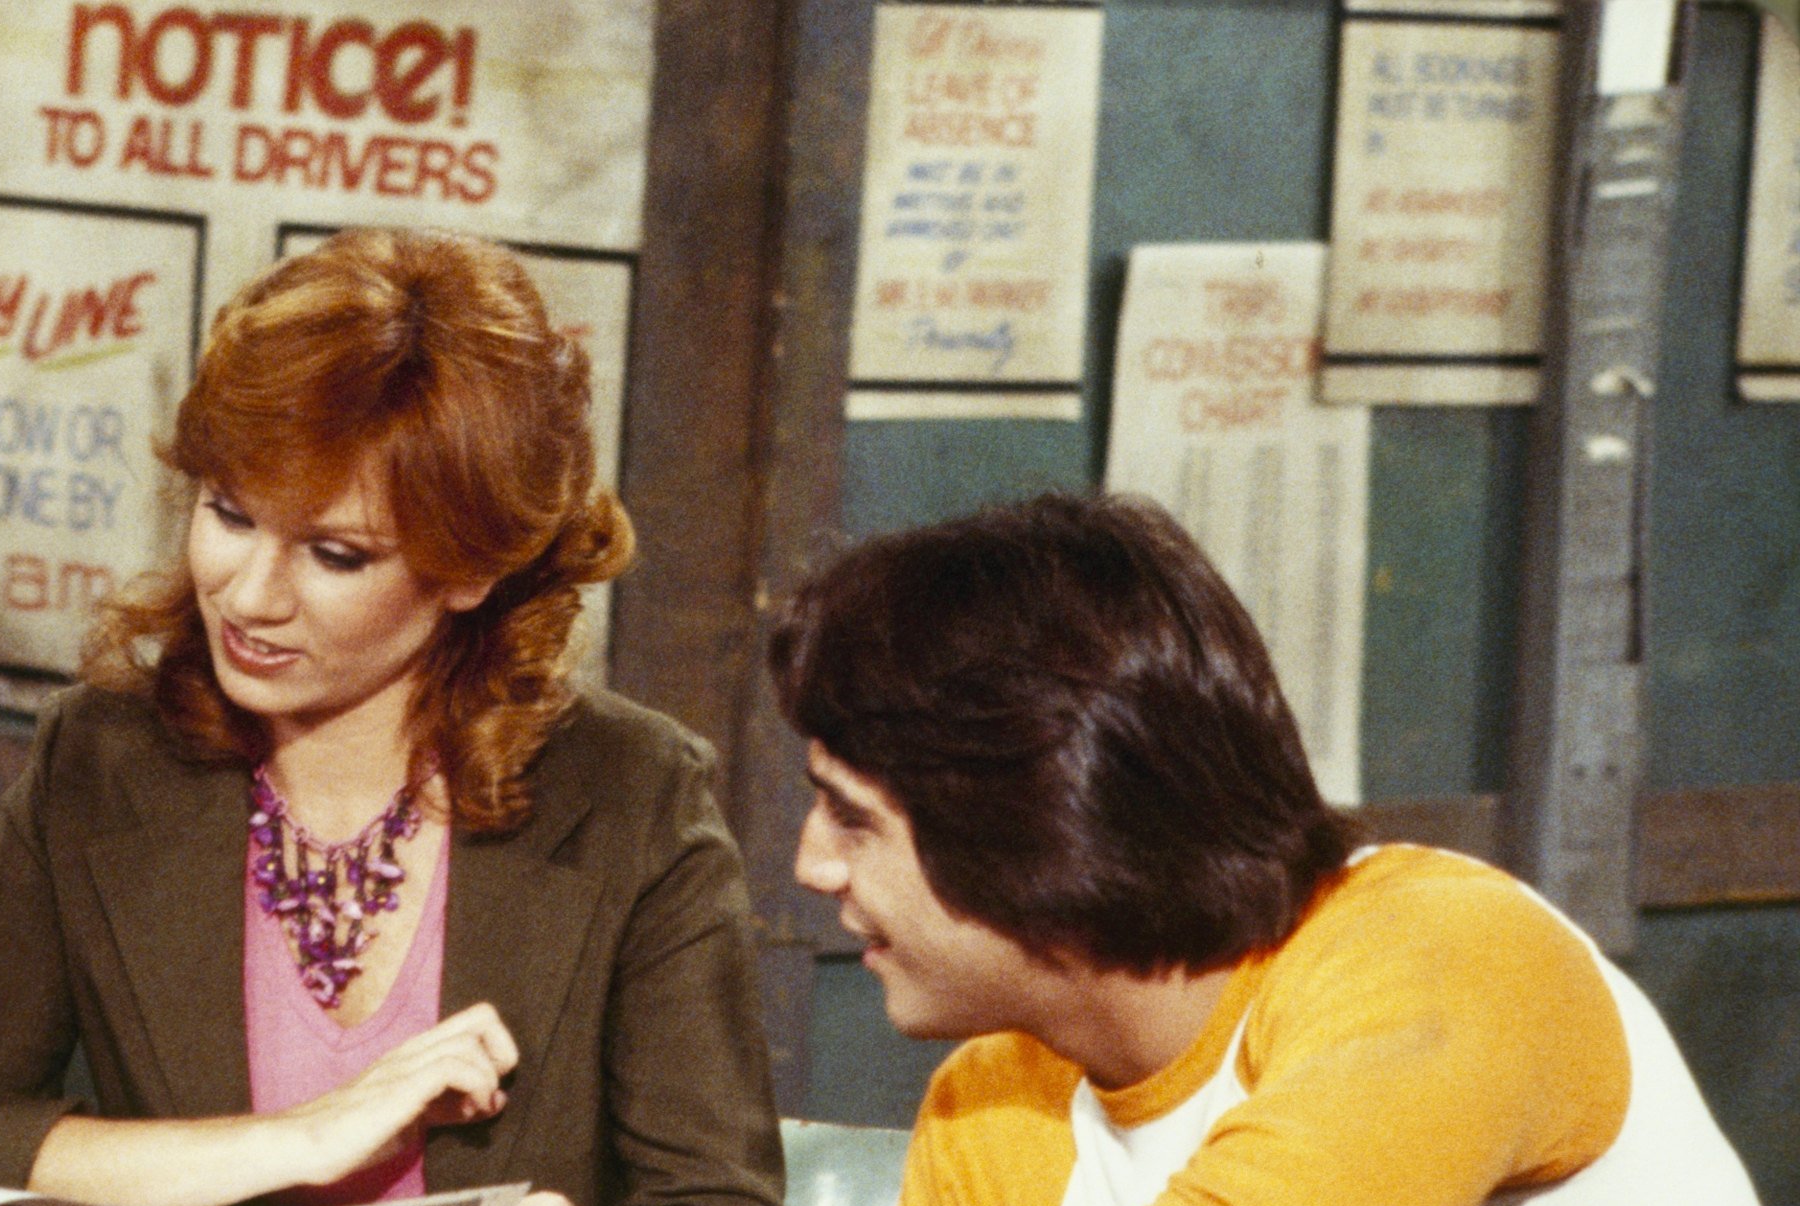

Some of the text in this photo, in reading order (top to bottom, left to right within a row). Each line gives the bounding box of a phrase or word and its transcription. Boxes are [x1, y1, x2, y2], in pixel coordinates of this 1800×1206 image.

[40, 106, 497, 204] TO ALL DRIVERS
[21, 271, 157, 362] LINE
[66, 403, 126, 463] OR
[66, 469, 125, 533] BY
